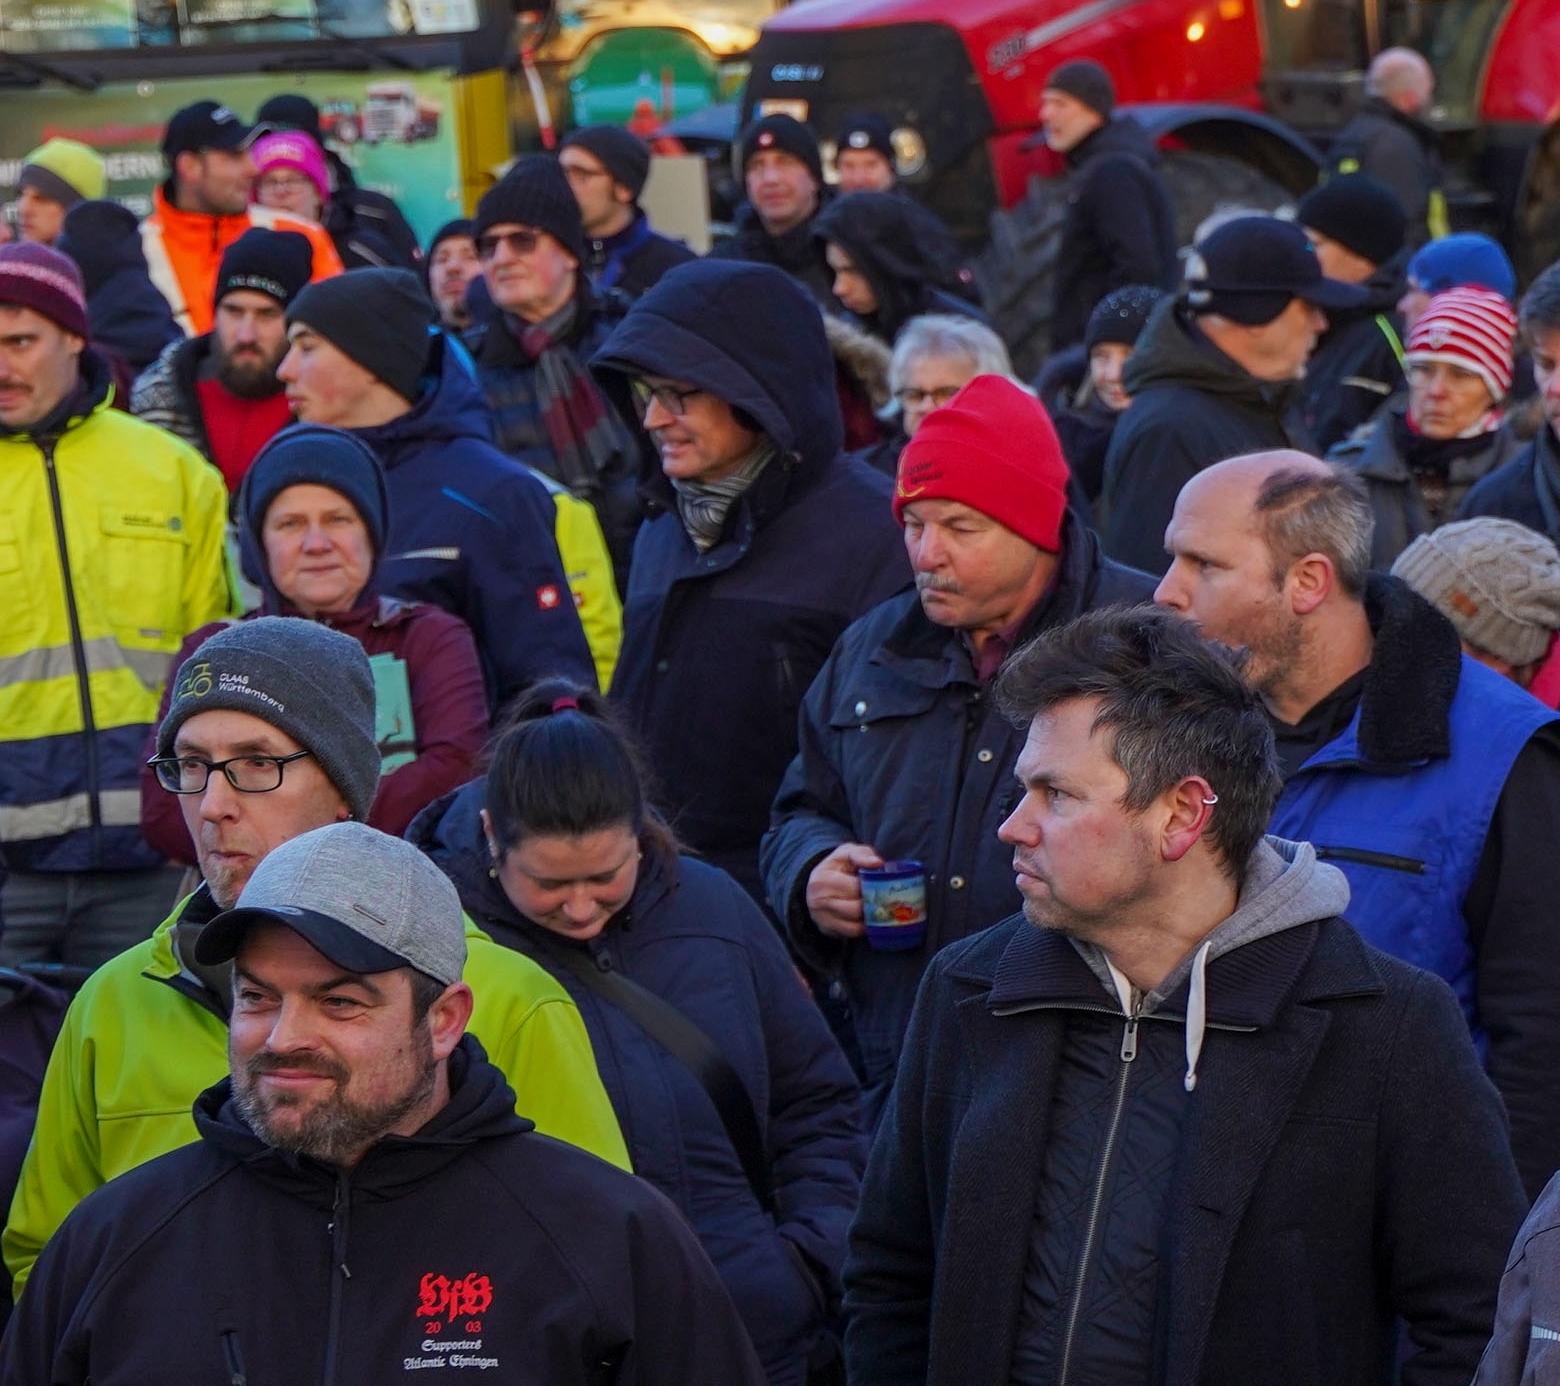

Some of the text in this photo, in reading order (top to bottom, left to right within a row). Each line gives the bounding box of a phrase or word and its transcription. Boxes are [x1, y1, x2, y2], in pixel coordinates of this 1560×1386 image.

[219, 673, 249, 685] CLAAS
[219, 682, 286, 713] Württemberg
[425, 1320, 482, 1334] 20 03
[421, 1339, 482, 1353] Supporters
